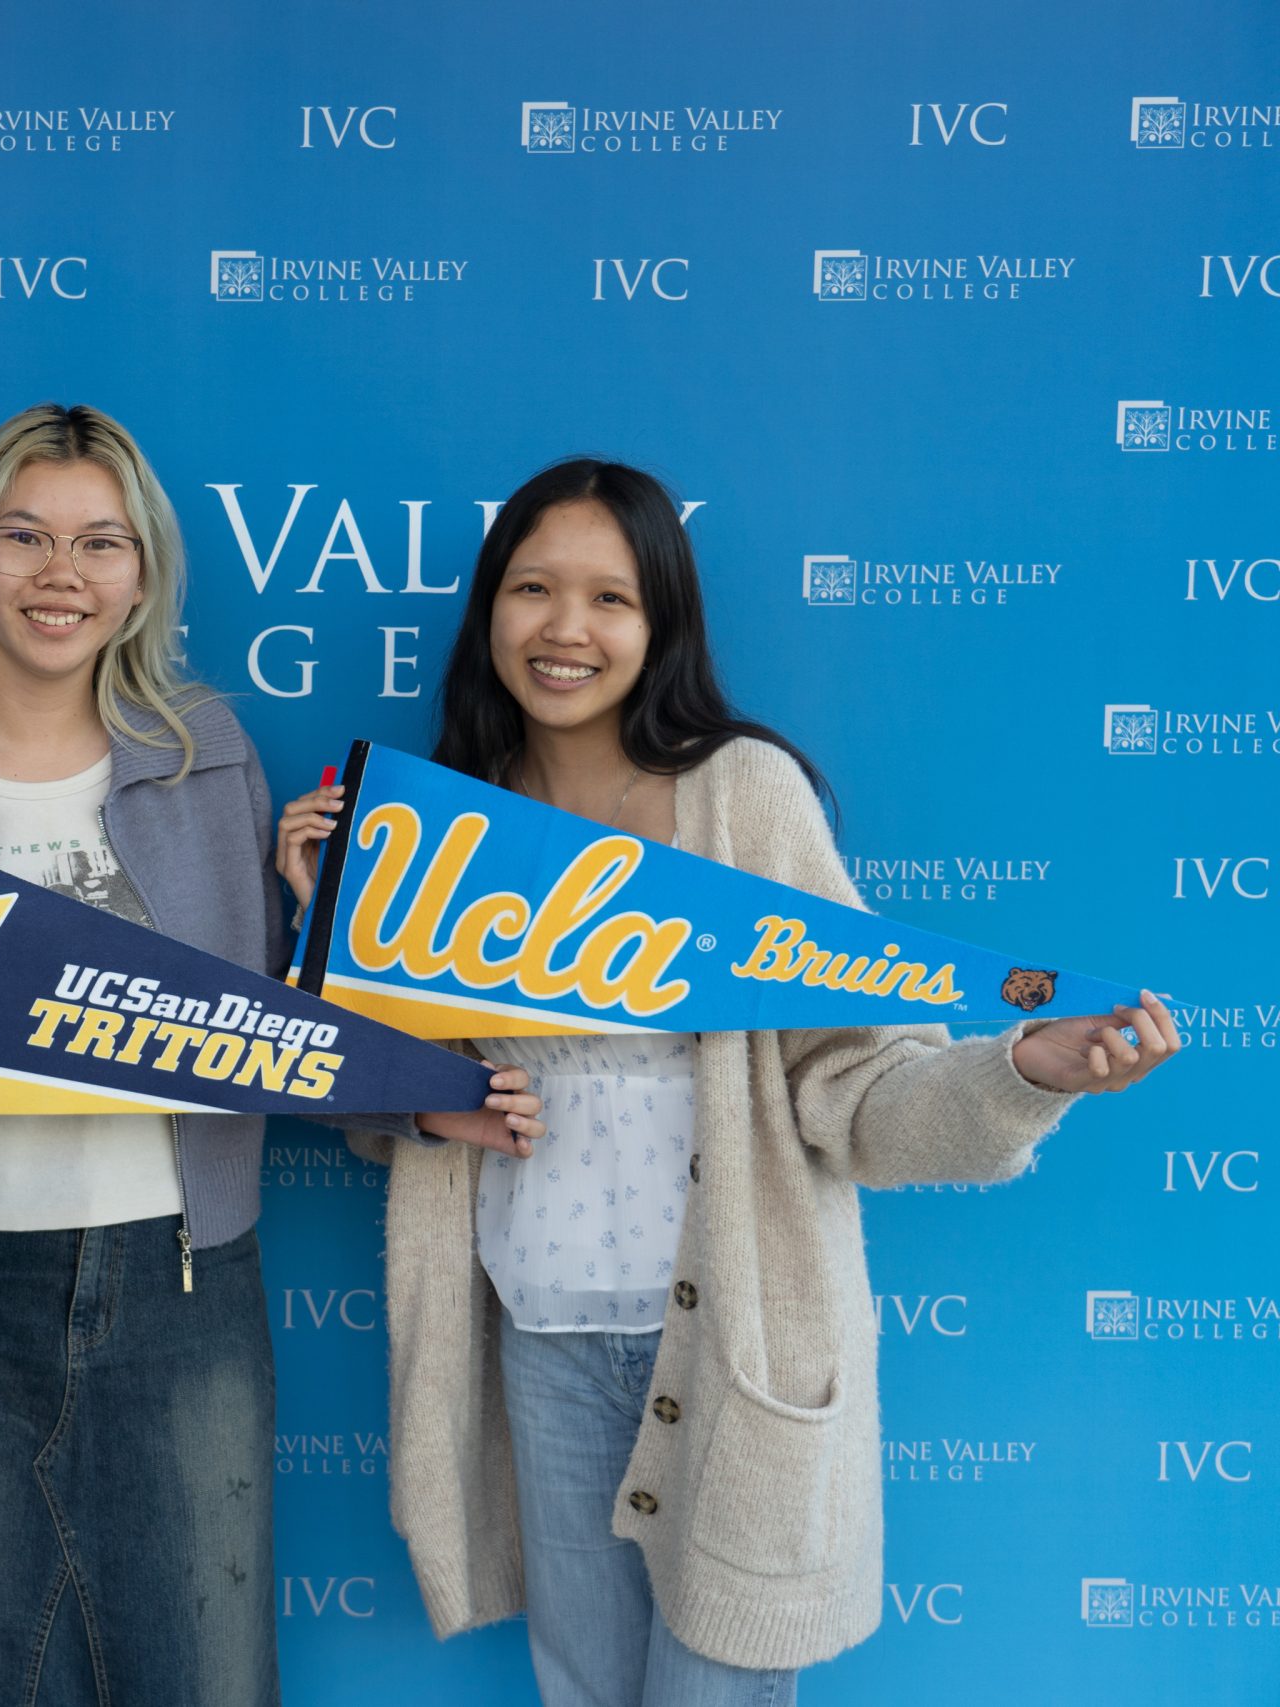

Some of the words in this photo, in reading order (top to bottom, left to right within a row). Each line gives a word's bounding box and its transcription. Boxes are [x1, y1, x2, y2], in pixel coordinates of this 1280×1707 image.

[79, 108, 174, 130] VALLEY
[301, 106, 396, 148] IVC
[584, 108, 674, 131] IRVINE
[685, 107, 782, 130] VALLEY
[910, 103, 1007, 145] IVC
[581, 136, 726, 152] COLLEGE
[1191, 131, 1273, 148] COLL
[272, 258, 361, 280] IRVINE
[372, 258, 468, 280] VALLEY
[593, 258, 688, 300] IVC
[875, 256, 966, 279] IRVINE
[977, 256, 1075, 278] VALLEY
[270, 285, 413, 301] COLLEGE
[873, 284, 1019, 299] COLLEGE
[1178, 407, 1271, 430] IRVINE
[1176, 434, 1276, 451] COLLE
[864, 561, 954, 584] IRVINE
[965, 561, 1061, 584] VALLEY
[1185, 559, 1280, 601] IVC
[861, 589, 1006, 604] COLLEGE
[1164, 711, 1257, 734] IRVINE
[854, 857, 945, 880] IRVINE
[954, 857, 1051, 881] VALLEY
[1174, 858, 1269, 899] IVC
[731, 915, 965, 1005] Bruins
[27, 998, 345, 1099] TRITONS
[1180, 1031, 1276, 1048] OLLEG
[269, 1148, 346, 1168] RVINE
[260, 1170, 378, 1187] COLLEG
[1164, 1151, 1258, 1193] IVC
[284, 1289, 375, 1330] IVC
[874, 1294, 967, 1336] IVC
[1146, 1297, 1236, 1320] IRVINE
[1144, 1323, 1280, 1340] COLLEG
[940, 1439, 1036, 1461] VALLEY
[1158, 1441, 1251, 1482] IVC
[276, 1458, 389, 1475] OLLEG
[885, 1464, 983, 1481] LLEGE
[284, 1577, 374, 1617] IVC
[885, 1584, 962, 1624] VC
[1141, 1584, 1230, 1607] IRVINE
